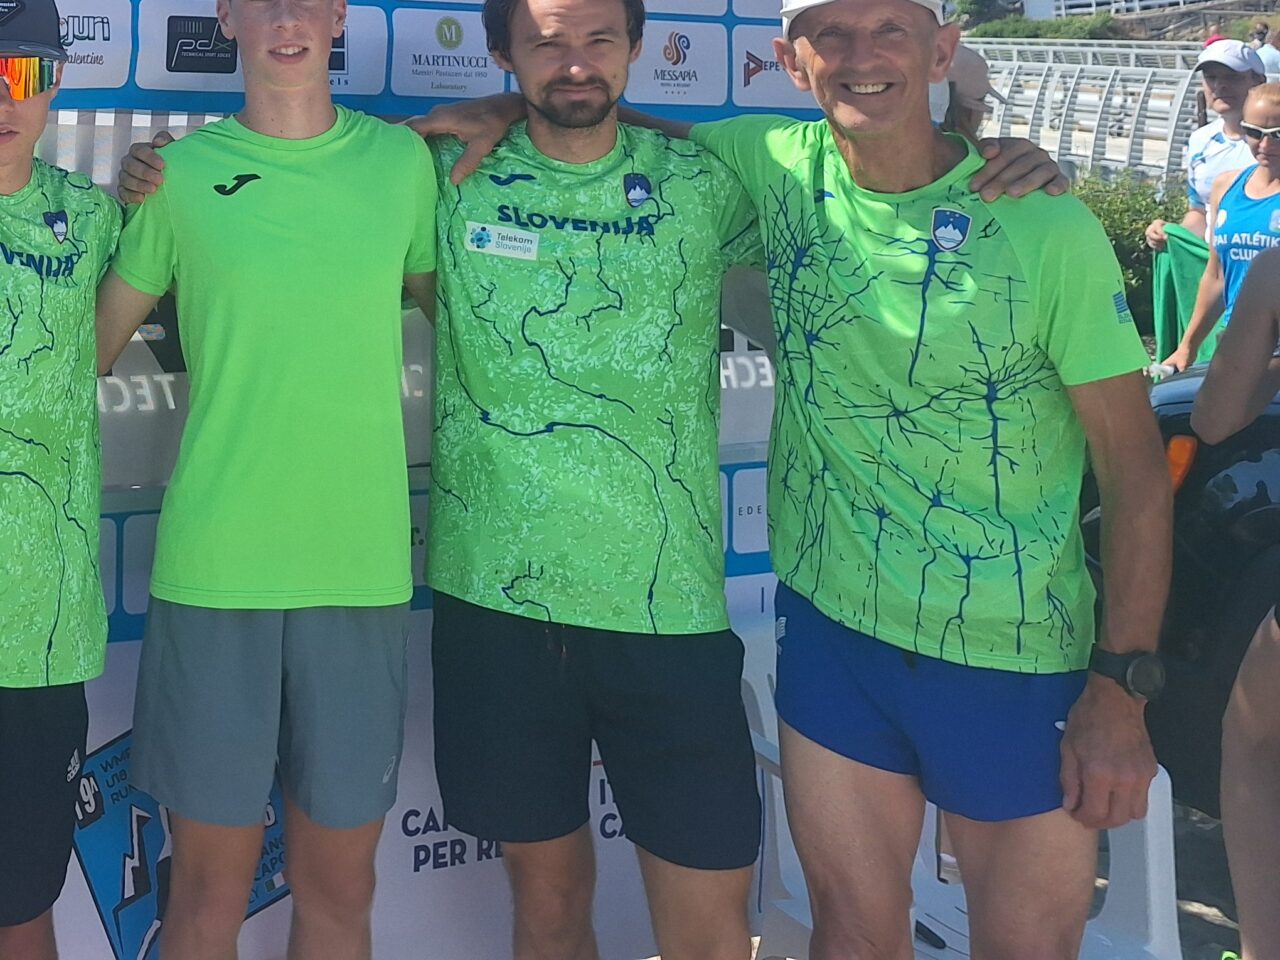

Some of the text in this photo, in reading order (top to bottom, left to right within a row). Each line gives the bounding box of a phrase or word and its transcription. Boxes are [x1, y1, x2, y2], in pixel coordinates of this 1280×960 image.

[412, 54, 488, 68] MARTINUCCI
[498, 204, 655, 236] SLOVENIJA
[497, 233, 533, 245] Telekom
[413, 838, 466, 872] PER
